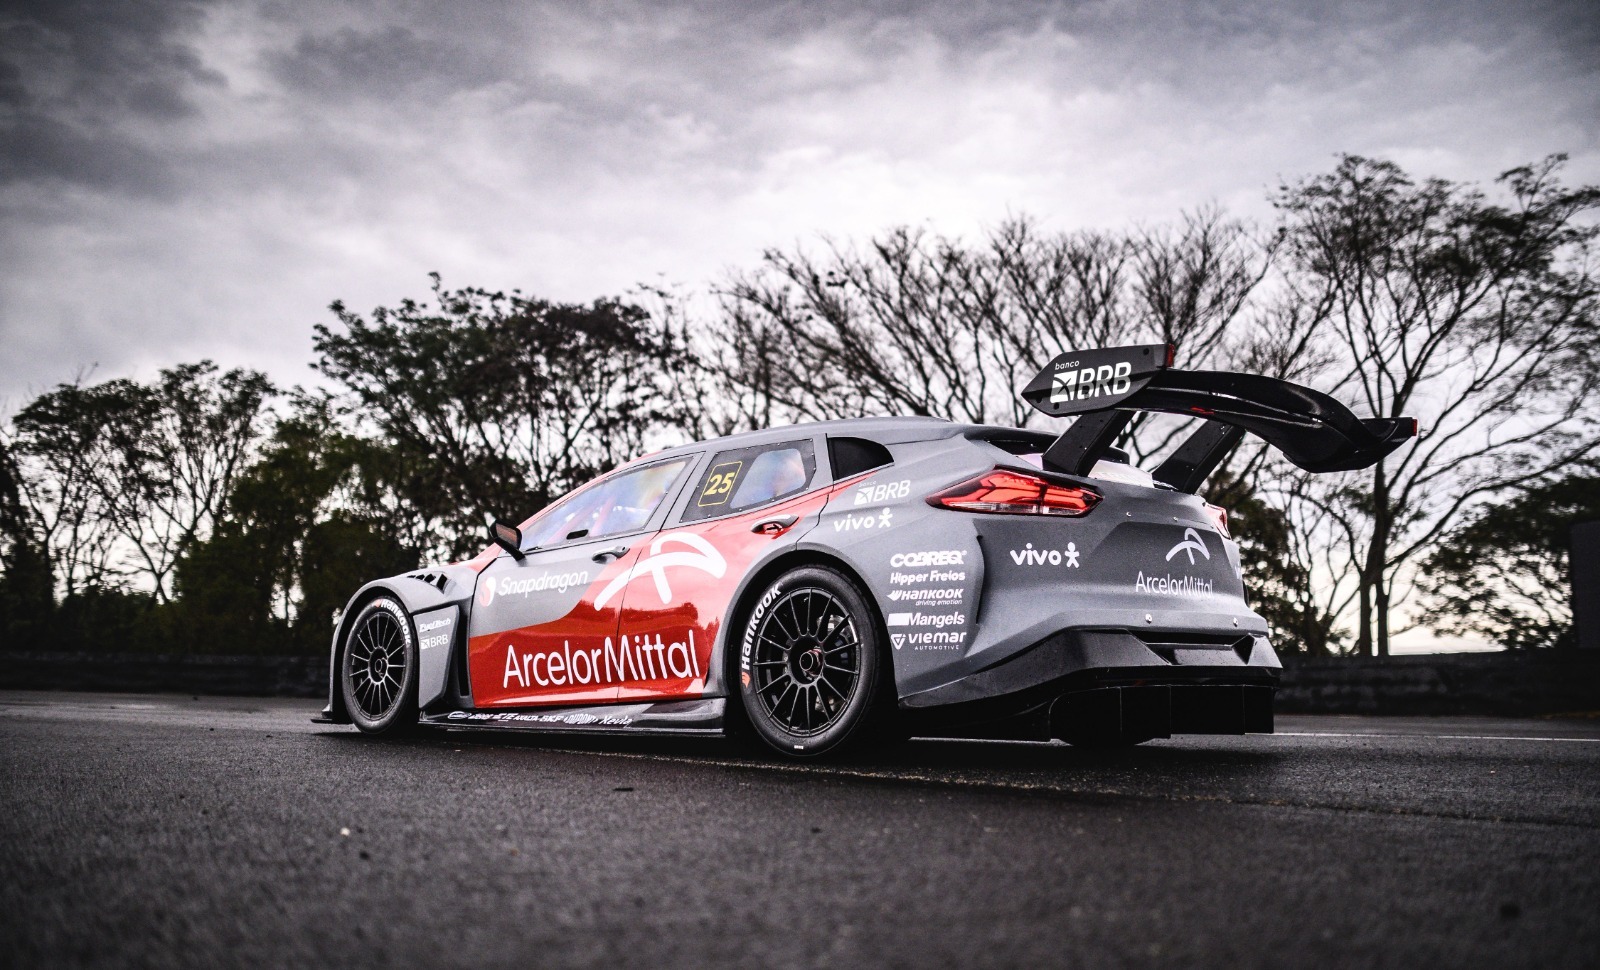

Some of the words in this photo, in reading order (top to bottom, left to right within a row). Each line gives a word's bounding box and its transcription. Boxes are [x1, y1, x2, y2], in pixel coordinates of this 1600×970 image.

[1055, 360, 1080, 371] banco
[1077, 362, 1132, 400] BRB
[703, 471, 736, 496] 25
[873, 479, 911, 502] BRB
[833, 513, 875, 532] vivo
[890, 550, 965, 568] COBREQ
[1010, 542, 1062, 566] vivo
[498, 570, 589, 598] Snapdragon
[890, 571, 929, 586] Hipper
[930, 569, 966, 582] Freios
[1135, 570, 1214, 599] ArcelorMittal
[937, 598, 963, 606] emotion
[909, 611, 965, 629] Mangels
[430, 634, 449, 648] BRB
[503, 629, 700, 689] ArcelorMittal
